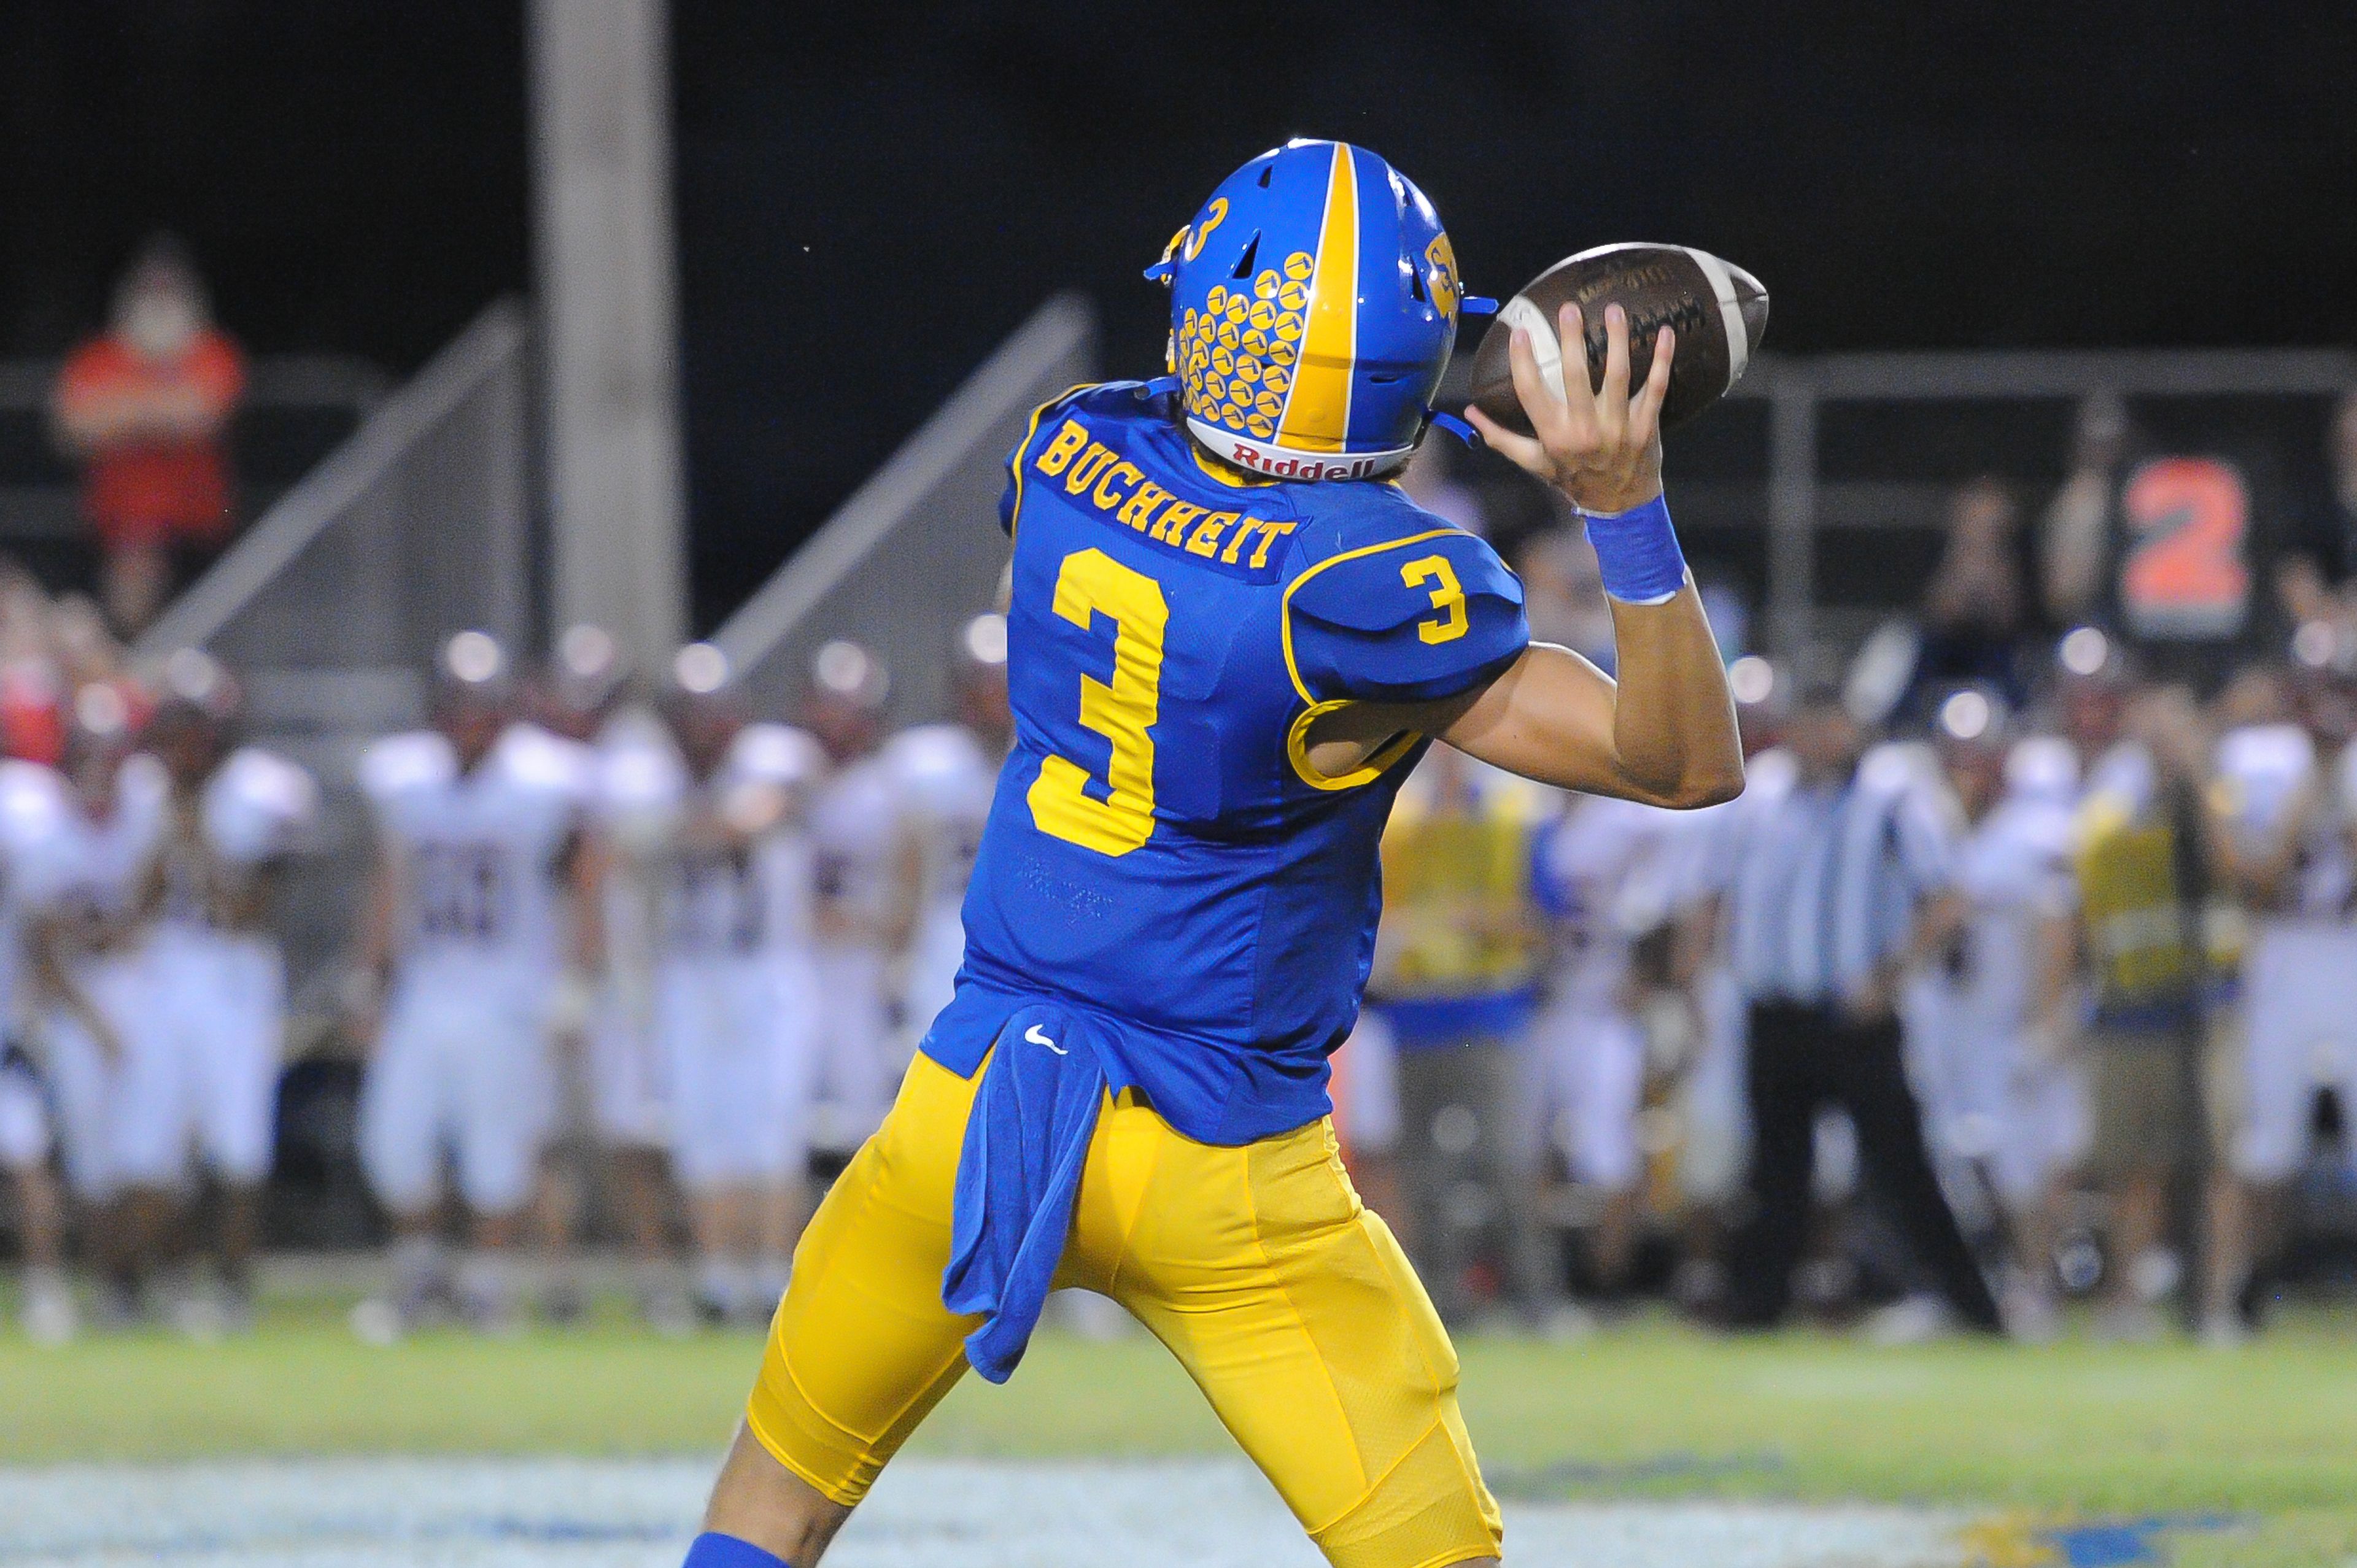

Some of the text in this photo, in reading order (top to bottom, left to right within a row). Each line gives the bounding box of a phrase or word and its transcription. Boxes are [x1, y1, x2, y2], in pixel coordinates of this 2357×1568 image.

[1185, 197, 1228, 261] 3
[1037, 419, 1297, 568] BUCHHEIT
[1233, 436, 1375, 481] Riddell
[2123, 457, 2249, 604] 2
[1400, 555, 1469, 645] 3
[1027, 547, 1169, 857] 3
